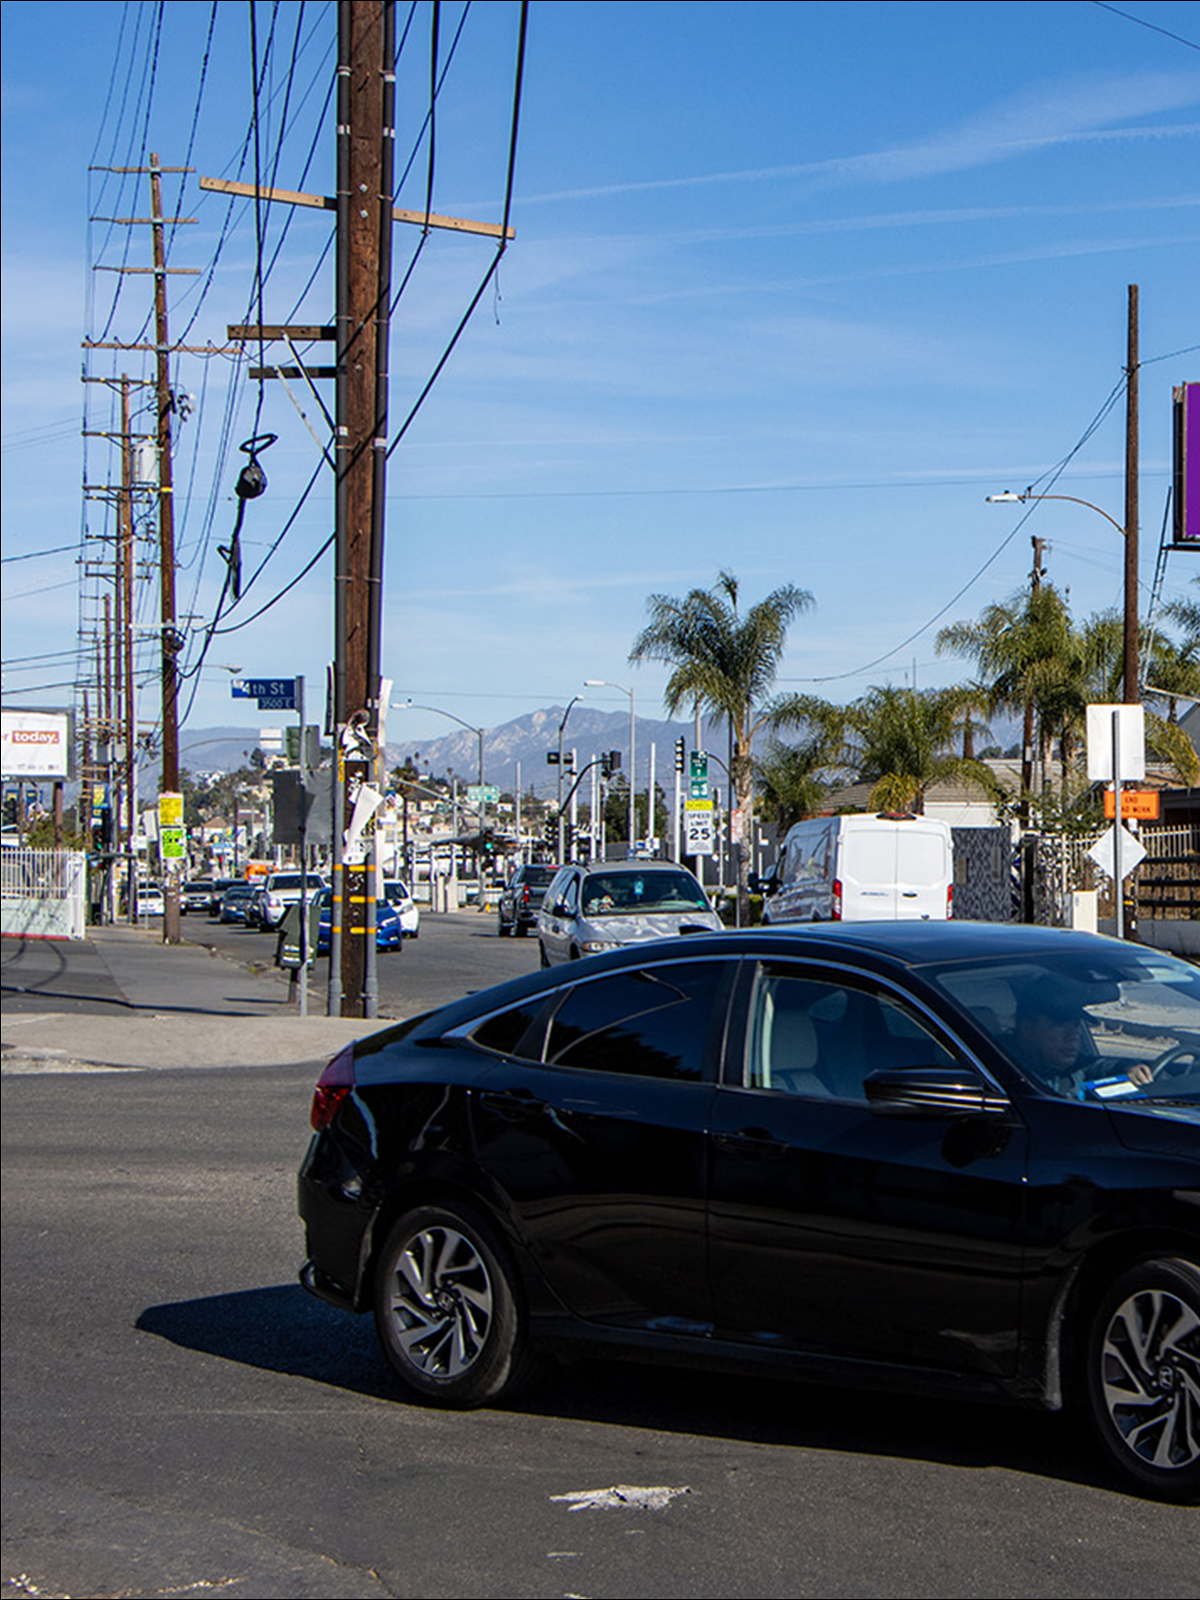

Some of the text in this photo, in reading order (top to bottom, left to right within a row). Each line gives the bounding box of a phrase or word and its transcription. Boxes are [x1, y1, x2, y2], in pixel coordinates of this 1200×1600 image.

[270, 681, 285, 695] St
[14, 731, 58, 744] today.
[1124, 796, 1139, 804] END
[689, 828, 711, 841] 25
